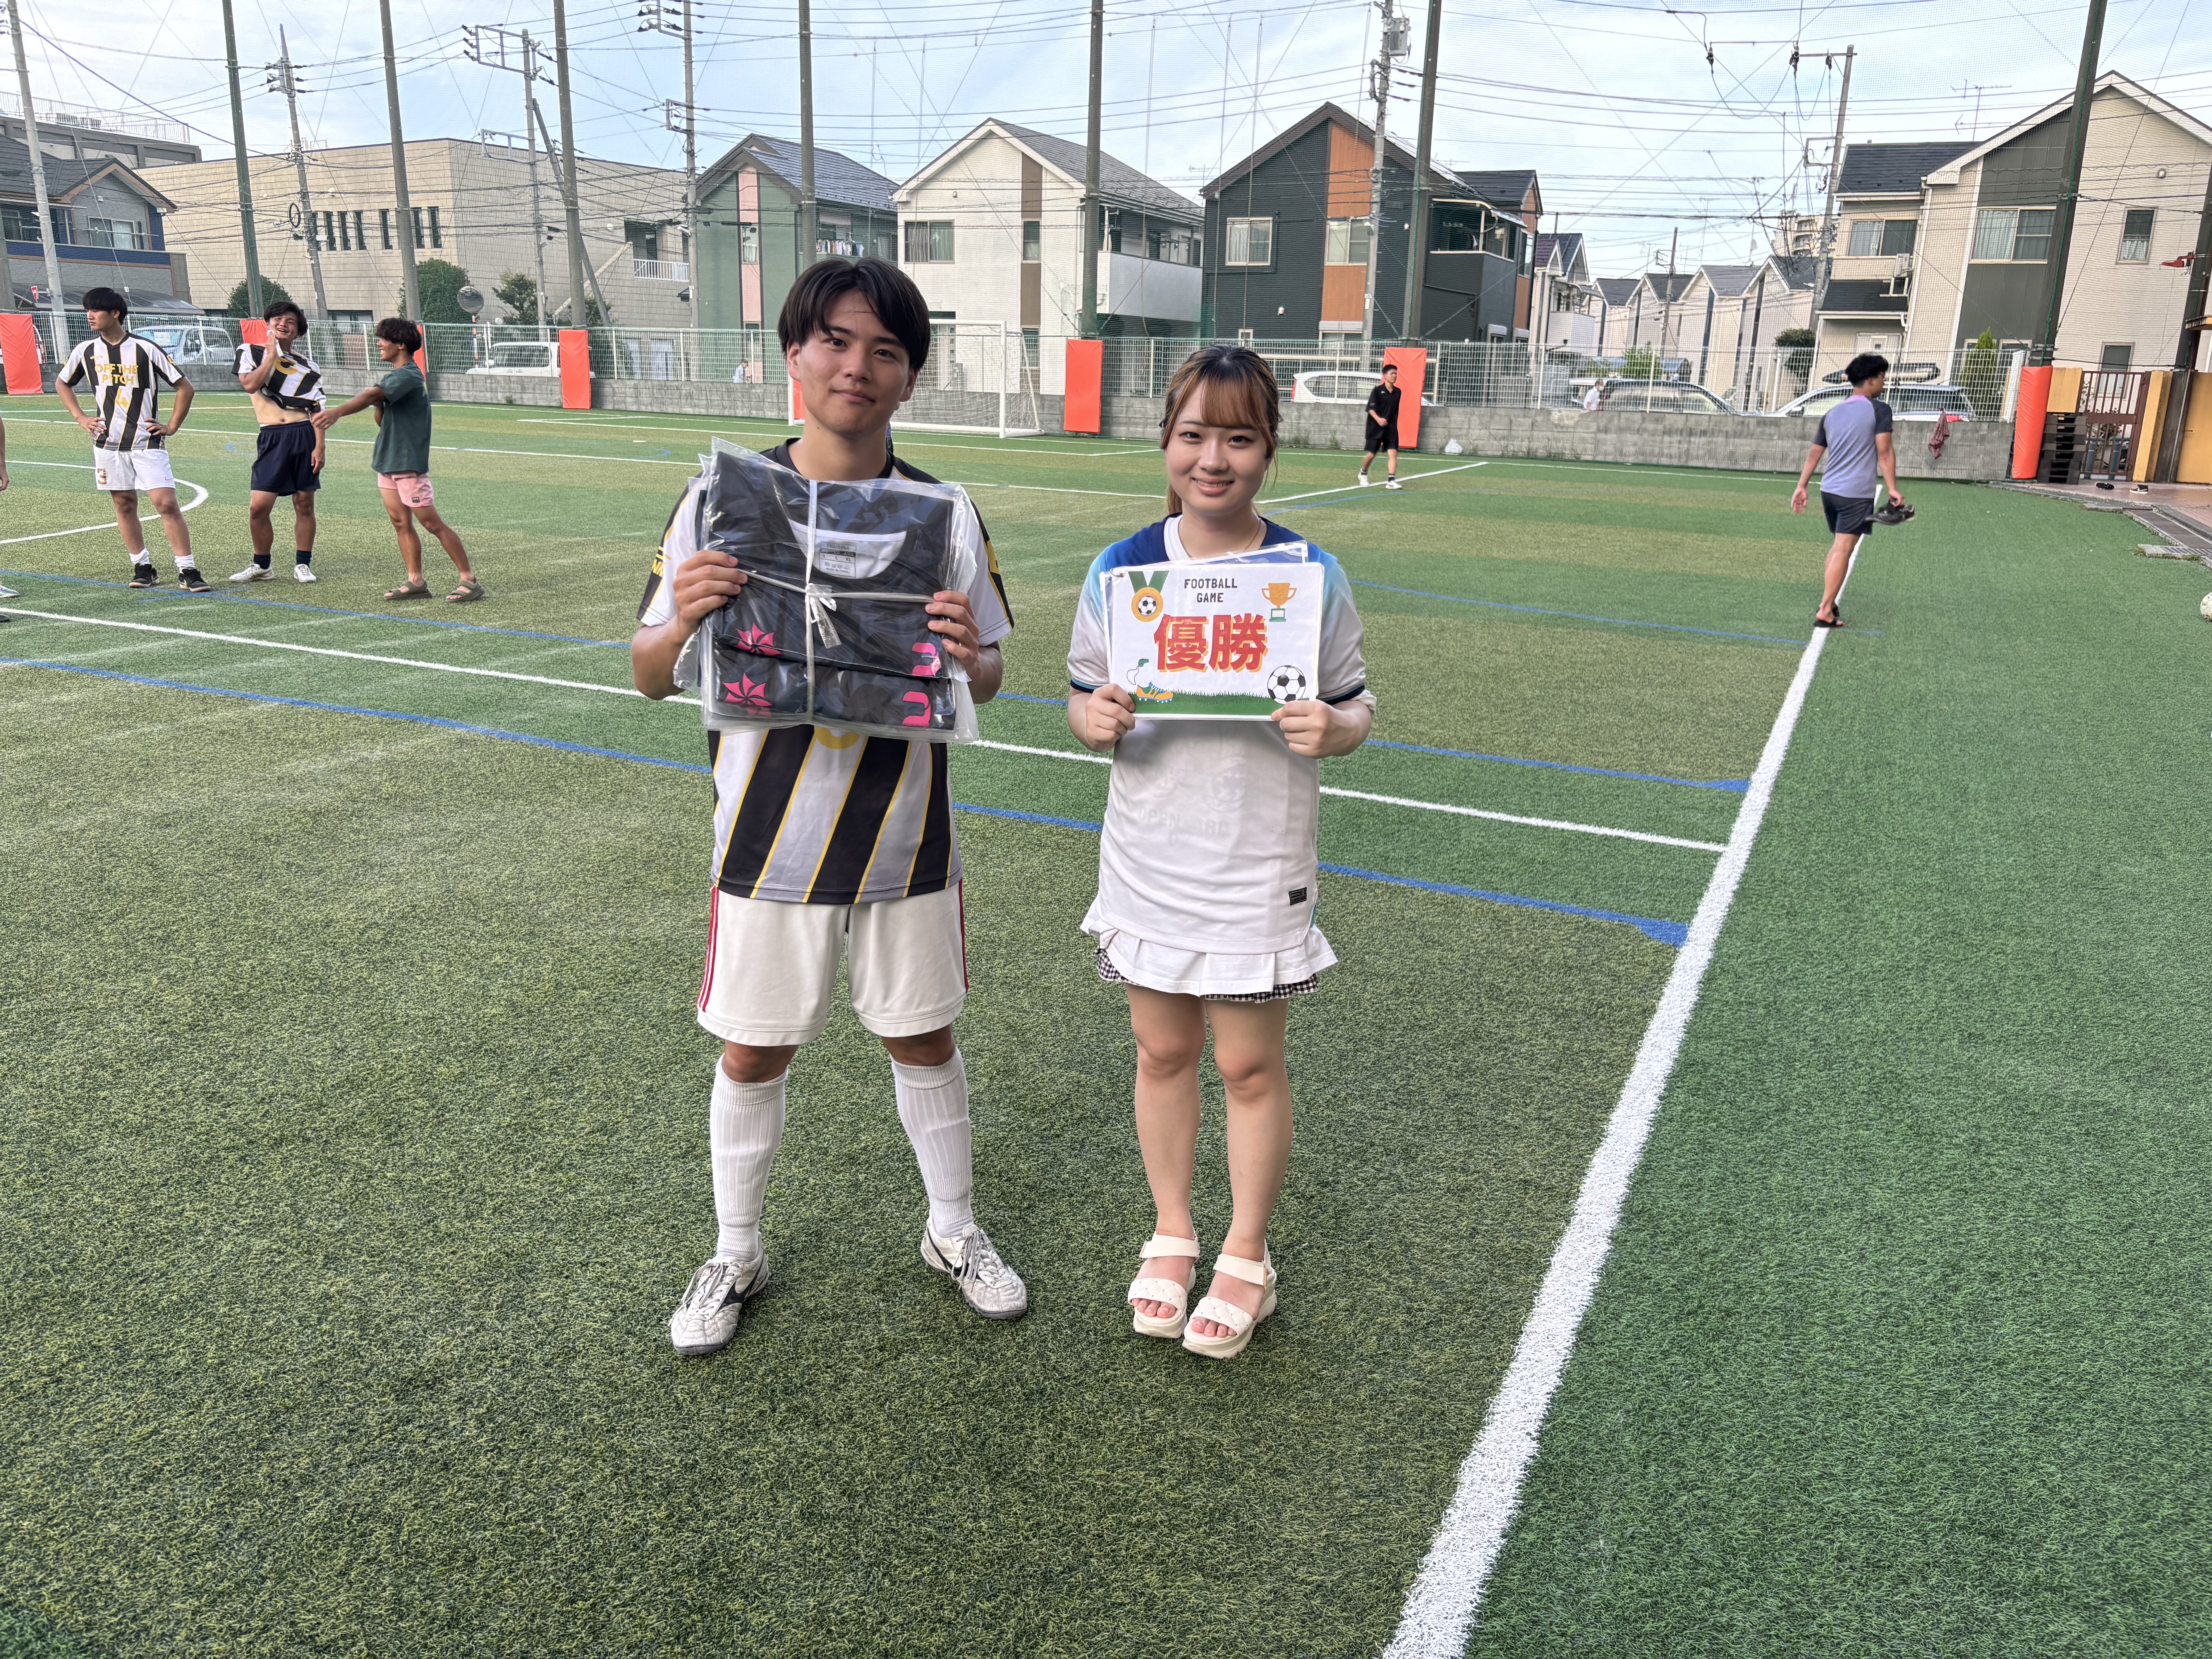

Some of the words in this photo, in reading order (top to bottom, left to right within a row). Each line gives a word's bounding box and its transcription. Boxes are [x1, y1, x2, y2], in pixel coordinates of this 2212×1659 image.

[95, 363, 115, 373] OFF
[117, 364, 138, 374] THE
[102, 374, 134, 385] PITCH
[115, 388, 128, 408] 4
[1184, 578, 1238, 589] FOOTBALL
[1196, 592, 1224, 603] GAME
[1154, 613, 1268, 673] 優勝
